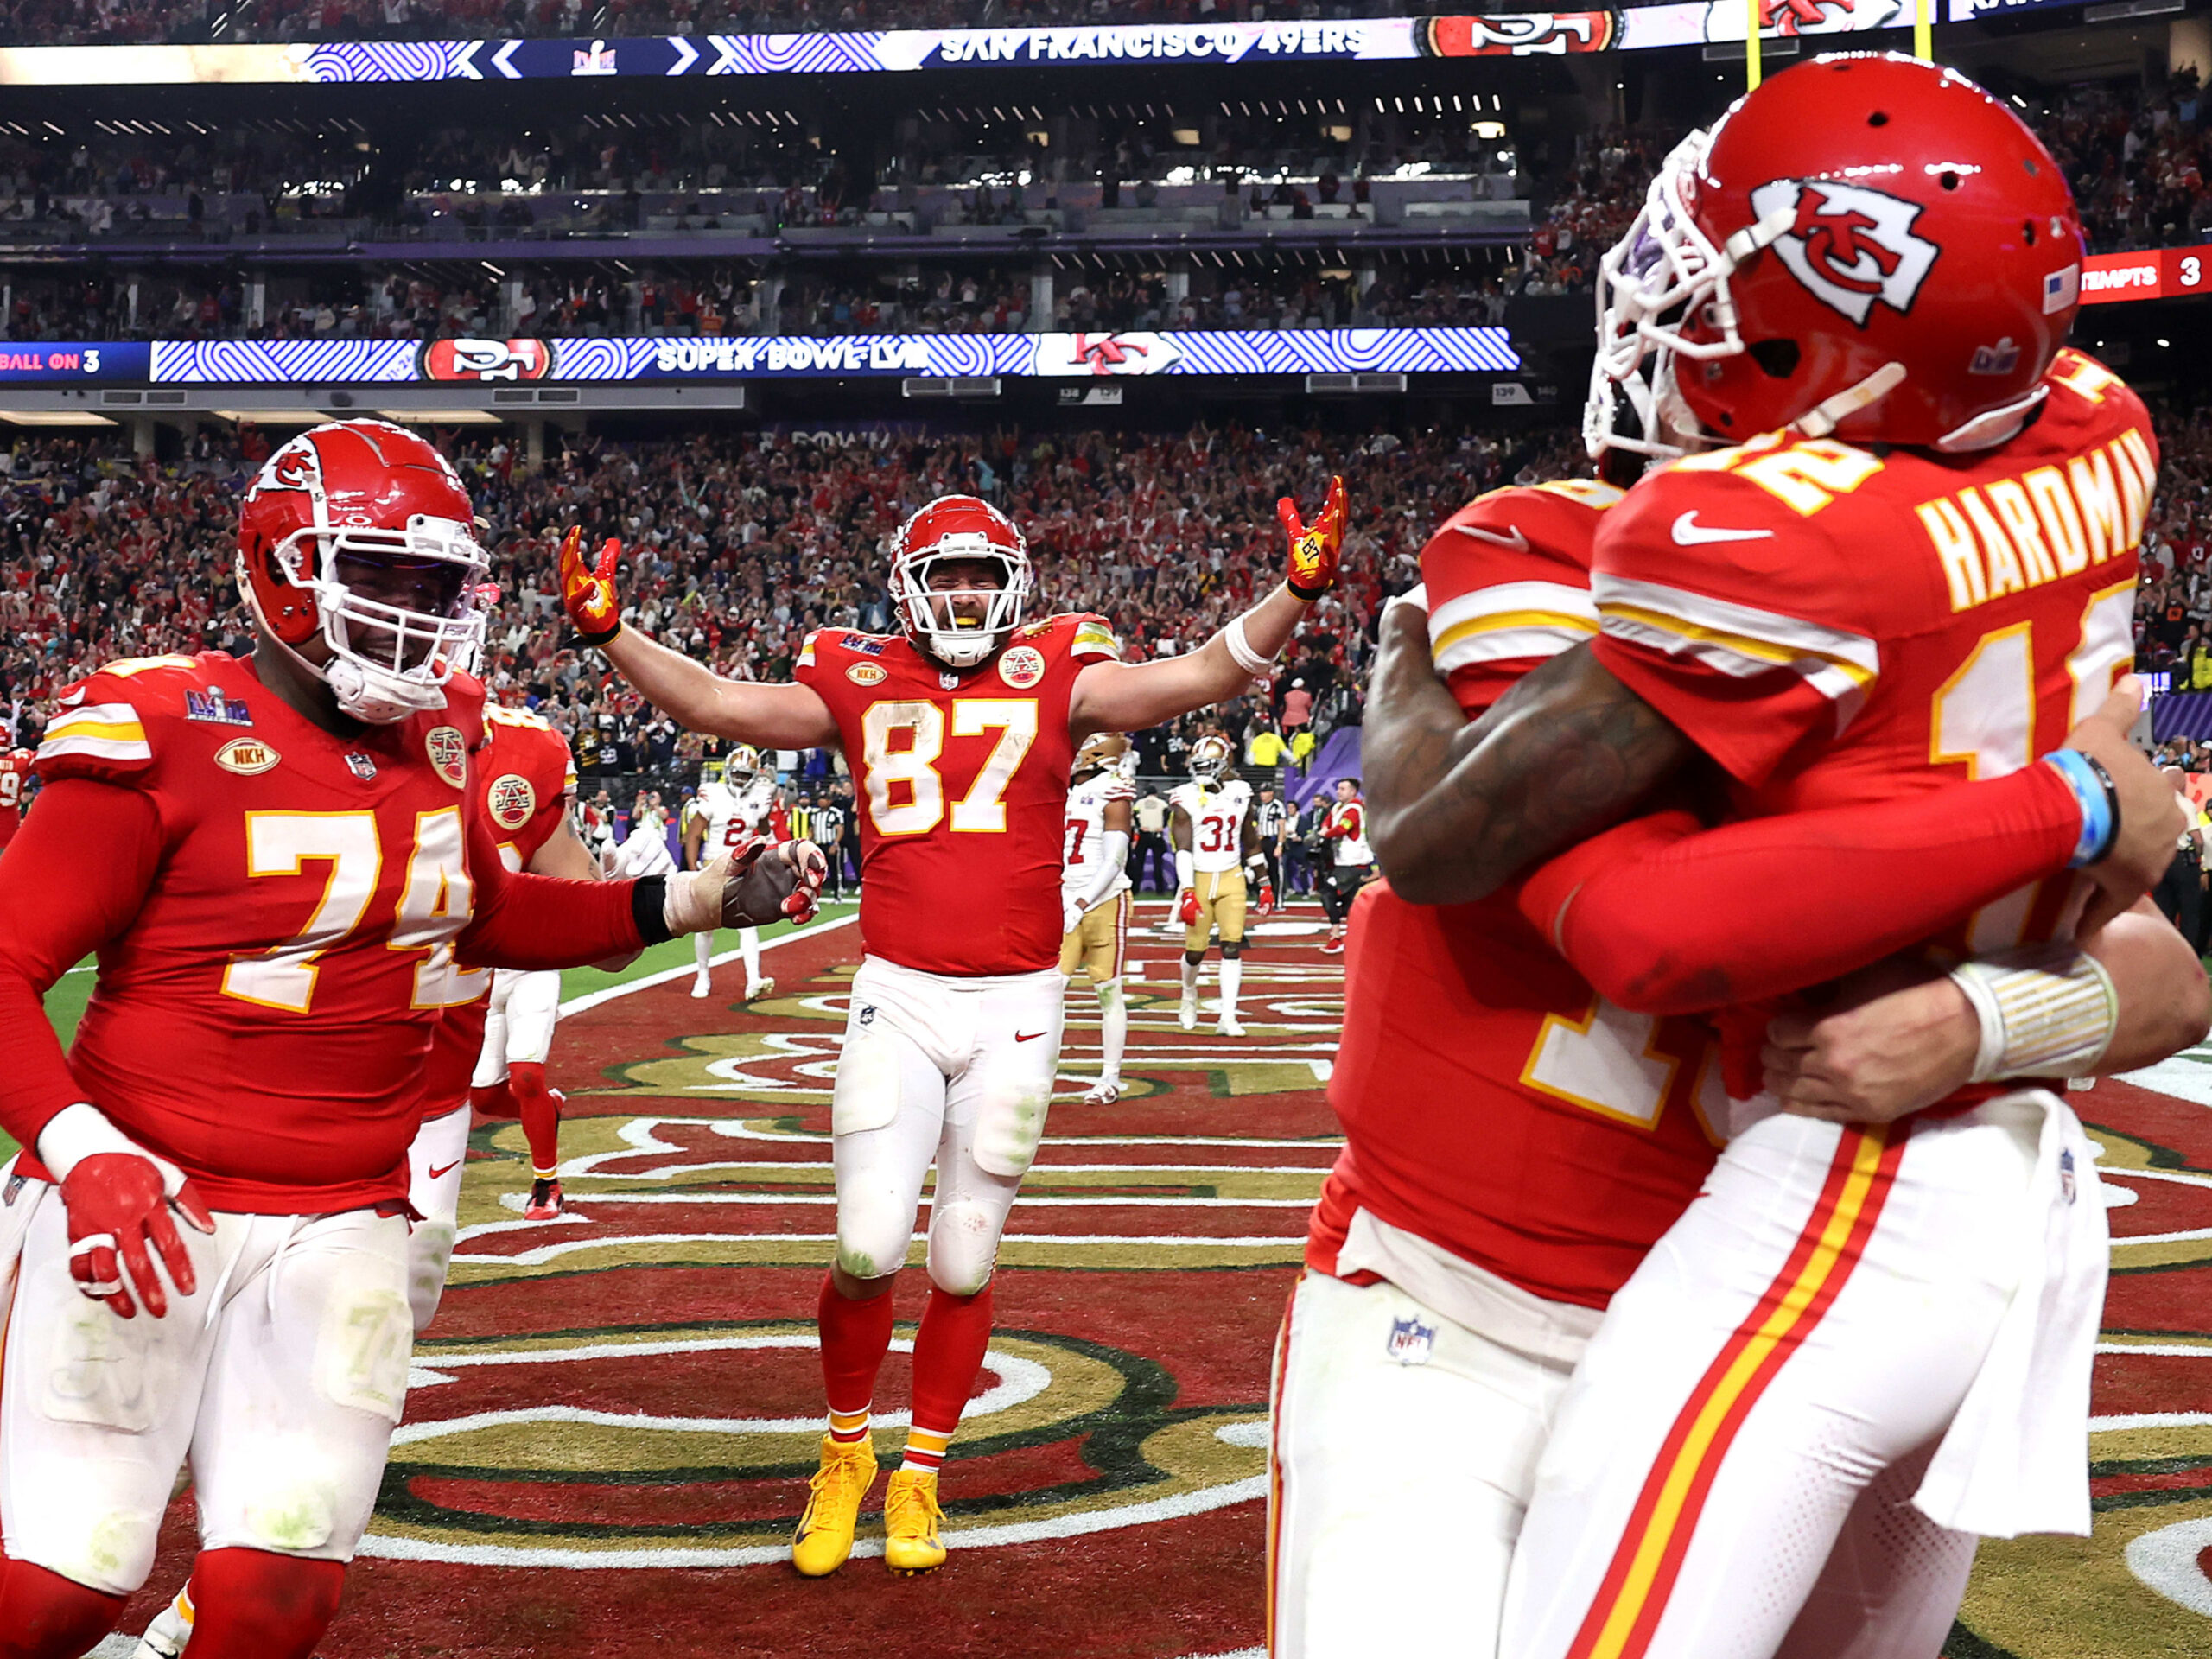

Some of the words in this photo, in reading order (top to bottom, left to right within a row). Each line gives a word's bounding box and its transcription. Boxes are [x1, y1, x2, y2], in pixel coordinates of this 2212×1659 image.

[940, 33, 1017, 61] SAN
[1029, 25, 1243, 60] FRANCISCO
[1258, 24, 1369, 54] 49ERS
[2180, 257, 2201, 286] 3
[0, 353, 44, 371] BALL
[48, 353, 79, 370] ON
[83, 350, 100, 373] 3
[658, 344, 754, 371] SUPER
[767, 343, 861, 370] BOWL
[1301, 537, 1320, 563] 87
[856, 669, 877, 680] NKH
[233, 748, 266, 765] NKH
[861, 697, 1039, 836] 87
[723, 817, 746, 847] 2
[1199, 814, 1237, 853] 31
[221, 804, 475, 1014] 74
